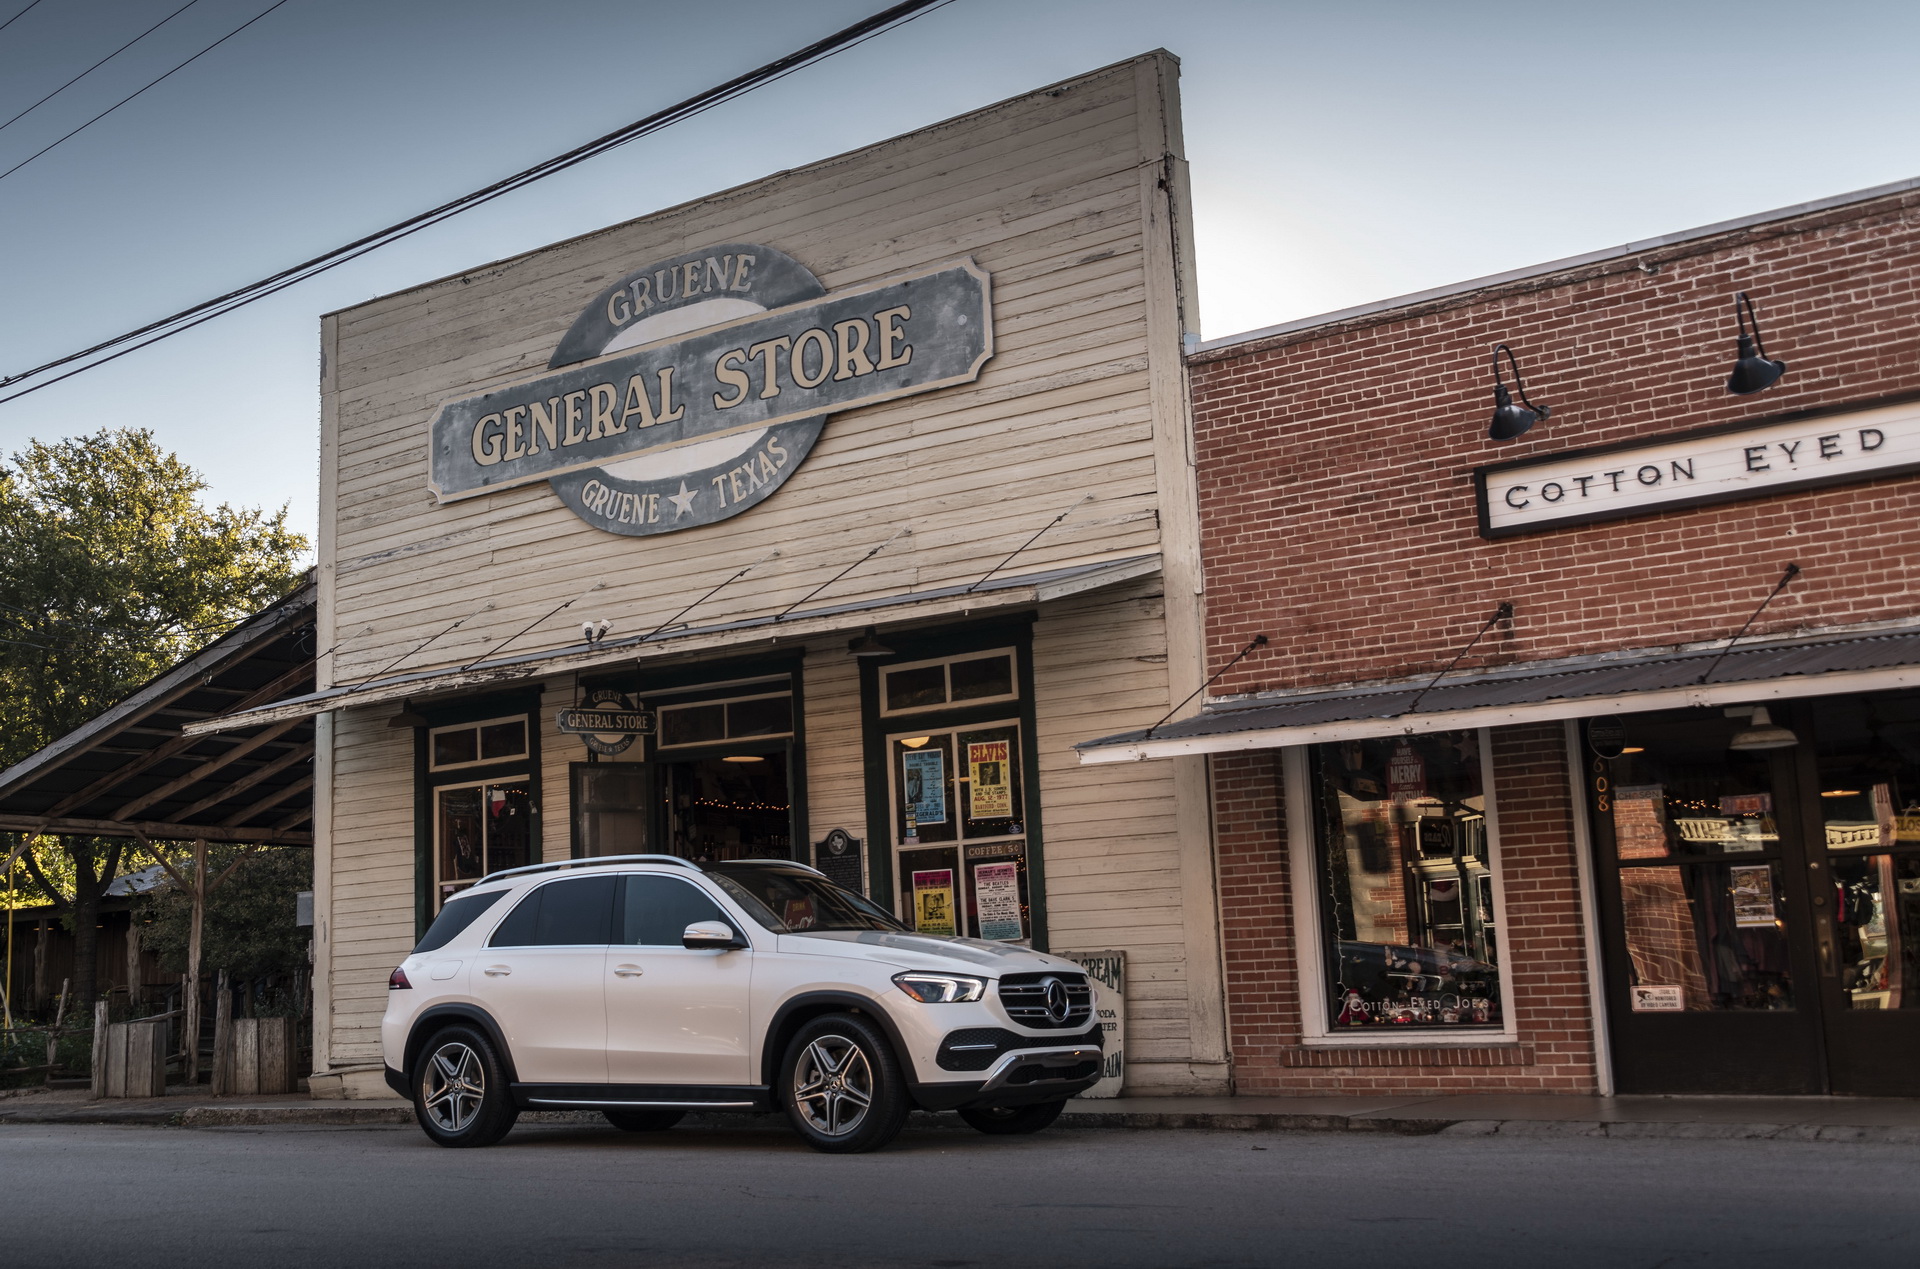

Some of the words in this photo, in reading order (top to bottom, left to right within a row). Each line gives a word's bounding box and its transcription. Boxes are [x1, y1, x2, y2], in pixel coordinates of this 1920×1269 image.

[606, 253, 756, 327] GRUENE
[471, 366, 685, 467] GENERAL
[712, 304, 912, 411] STORE
[1505, 458, 1695, 509] COTTON
[1743, 428, 1885, 472] EYED
[581, 478, 660, 525] GRUENE
[712, 436, 789, 508] TEXAS
[592, 690, 622, 703] GRUENE
[568, 713, 614, 728] GENERAL
[616, 715, 648, 729] STORE
[970, 742, 1007, 762] ELVIS
[1390, 764, 1421, 784] MERRY
[968, 845, 1003, 856] COFFEE
[1081, 957, 1122, 994] CREAM
[1350, 998, 1399, 1011] COTTON
[1411, 996, 1440, 1009] EYED
